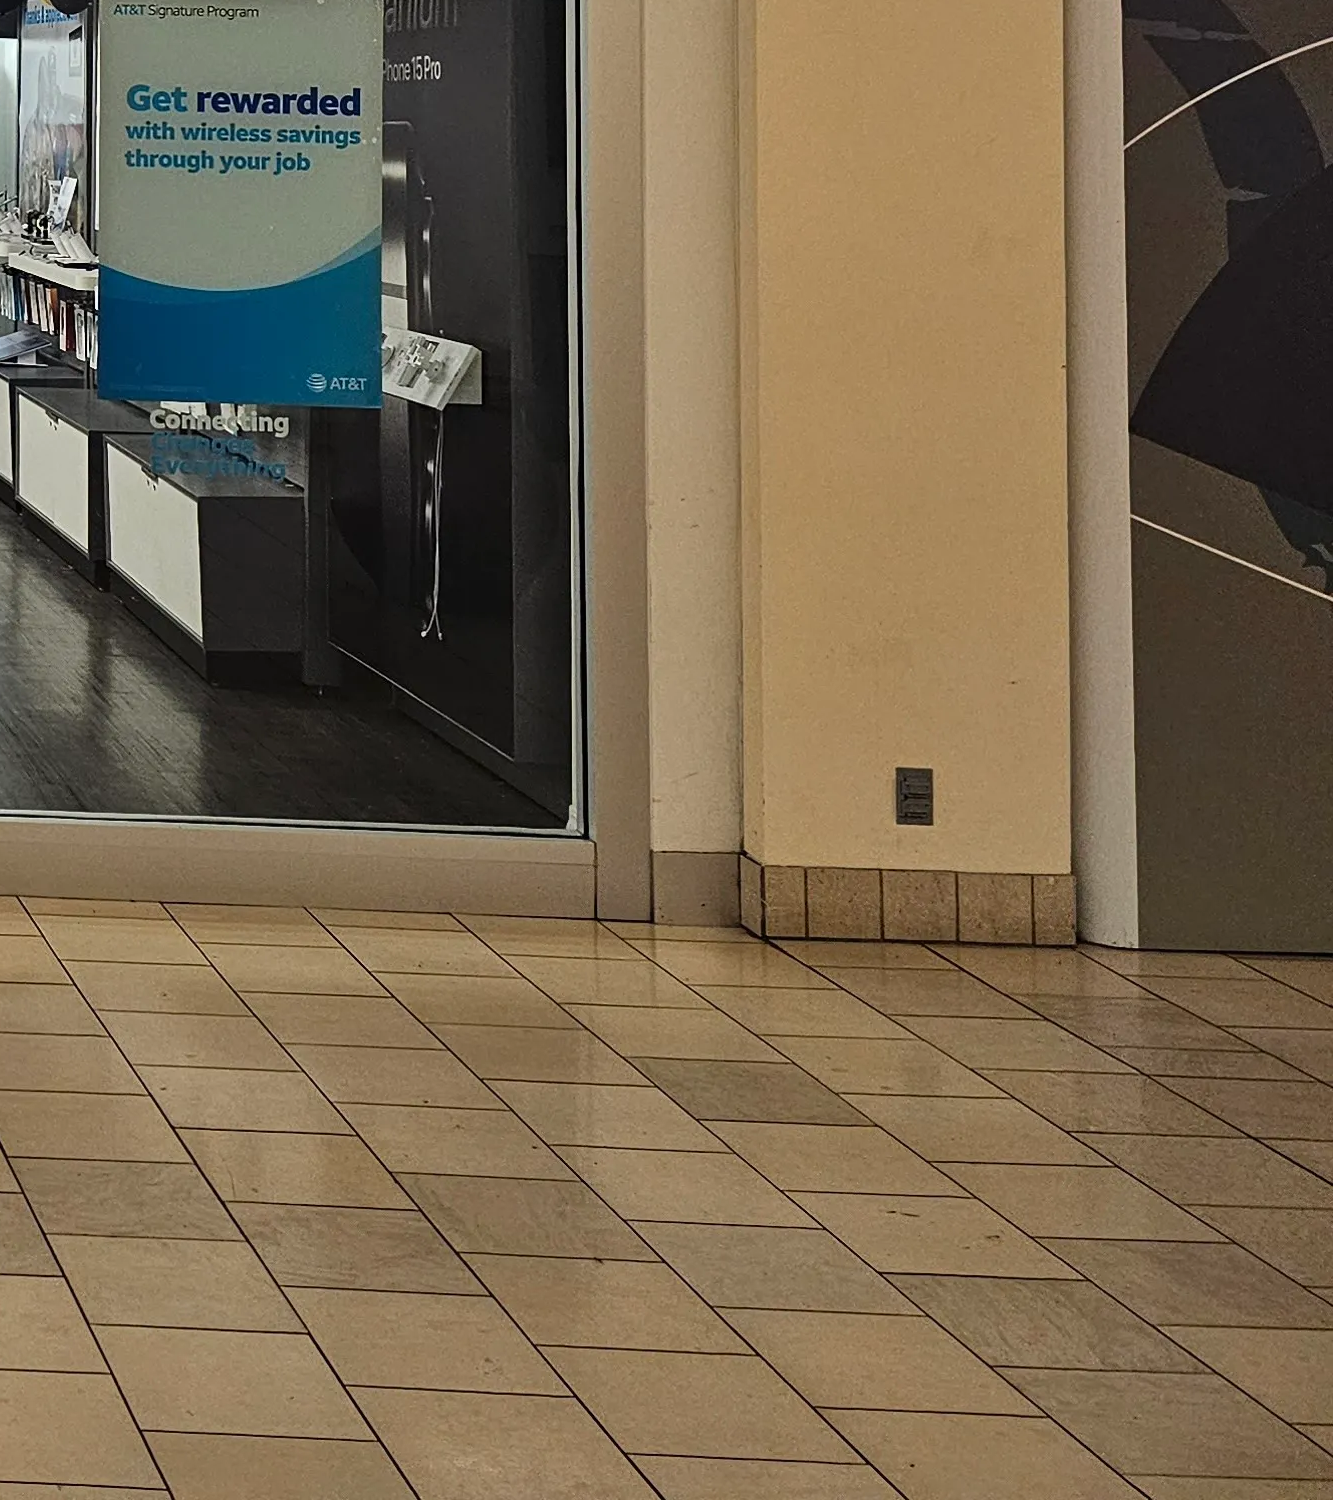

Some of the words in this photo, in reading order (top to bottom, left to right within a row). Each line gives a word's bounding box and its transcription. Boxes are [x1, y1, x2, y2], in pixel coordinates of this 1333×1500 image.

[113, 3, 147, 16] AT&T
[148, 4, 204, 20] Signature
[207, 4, 259, 20] Program
[411, 55, 423, 80] 15
[424, 55, 441, 80] Pro
[126, 84, 188, 113] Get
[196, 86, 361, 117] rewarded
[125, 121, 175, 141] with
[181, 123, 272, 143] wireless
[276, 125, 361, 149] savings
[125, 149, 214, 174] through
[219, 153, 270, 174] your
[273, 152, 311, 175] job
[329, 376, 367, 391] AT&T
[149, 408, 290, 438] Connecting
